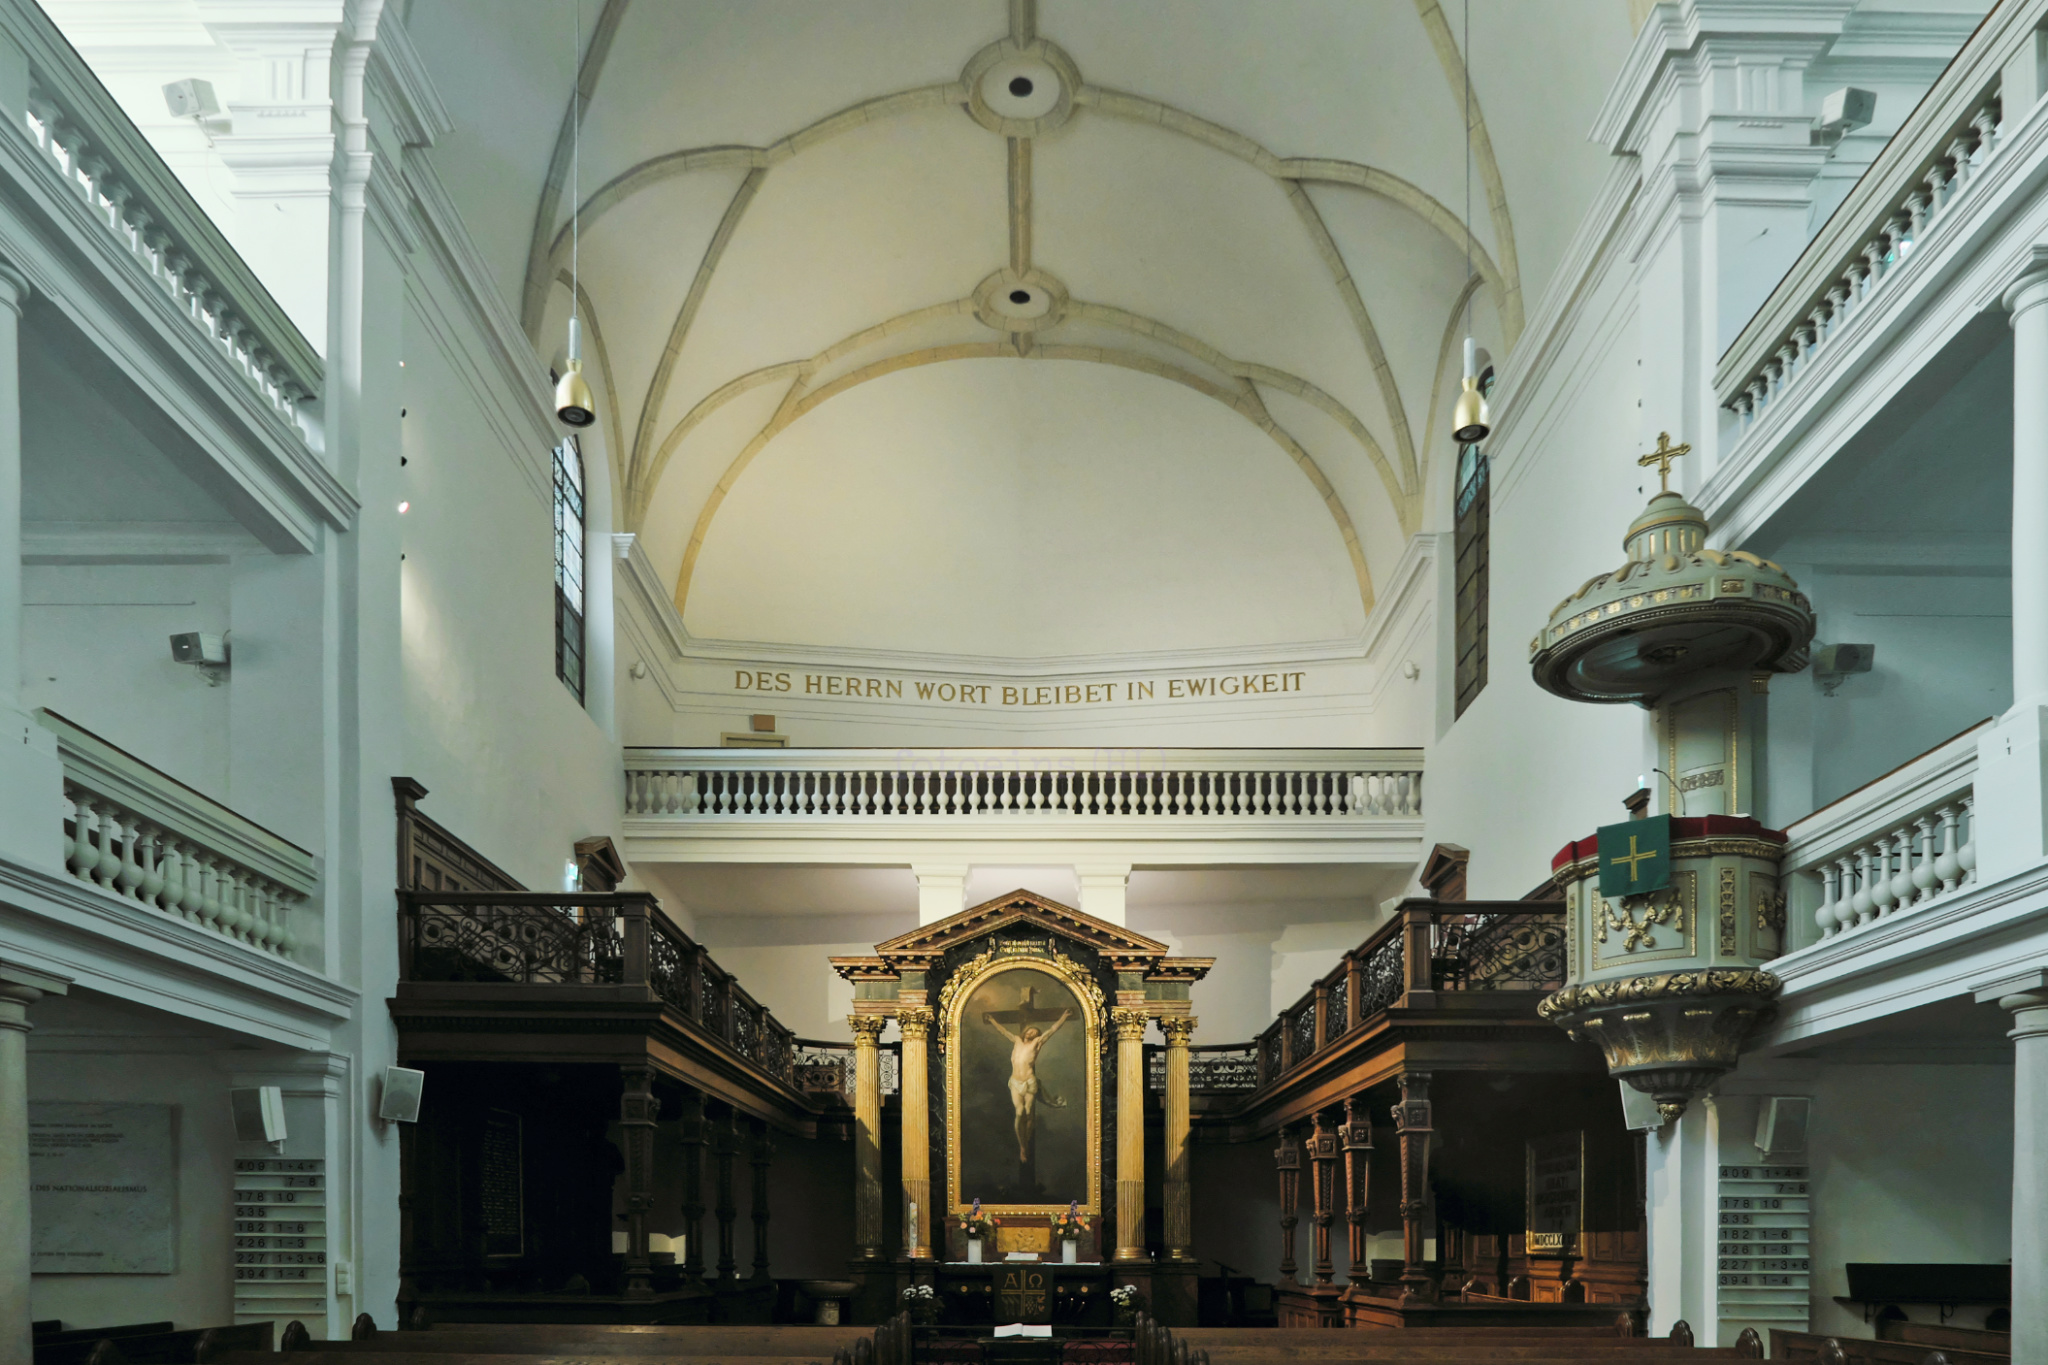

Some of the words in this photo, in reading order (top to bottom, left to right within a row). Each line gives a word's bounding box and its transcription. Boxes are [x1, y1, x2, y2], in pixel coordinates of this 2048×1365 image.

[735, 669, 791, 692] DES
[804, 674, 903, 699] HERRN
[914, 681, 992, 704] WORT
[1001, 683, 1118, 706] BLEIBET
[1127, 681, 1155, 701] IN
[1168, 671, 1306, 699] EWIGKEIT
[237, 1161, 265, 1171] 409
[1721, 1168, 1749, 1178] 409
[238, 1192, 264, 1202] 178
[278, 1192, 294, 1202] 10
[1723, 1199, 1750, 1208] 178
[1763, 1199, 1779, 1208] 10
[237, 1207, 265, 1217] 535
[1721, 1214, 1750, 1224] 535
[238, 1222, 265, 1232] 182
[1722, 1230, 1750, 1240] 182
[237, 1238, 265, 1248] 426
[1721, 1245, 1749, 1255] 426
[238, 1254, 265, 1263] 227
[1720, 1260, 1748, 1270] 227
[237, 1269, 265, 1279] 394
[1720, 1275, 1748, 1285] 394
